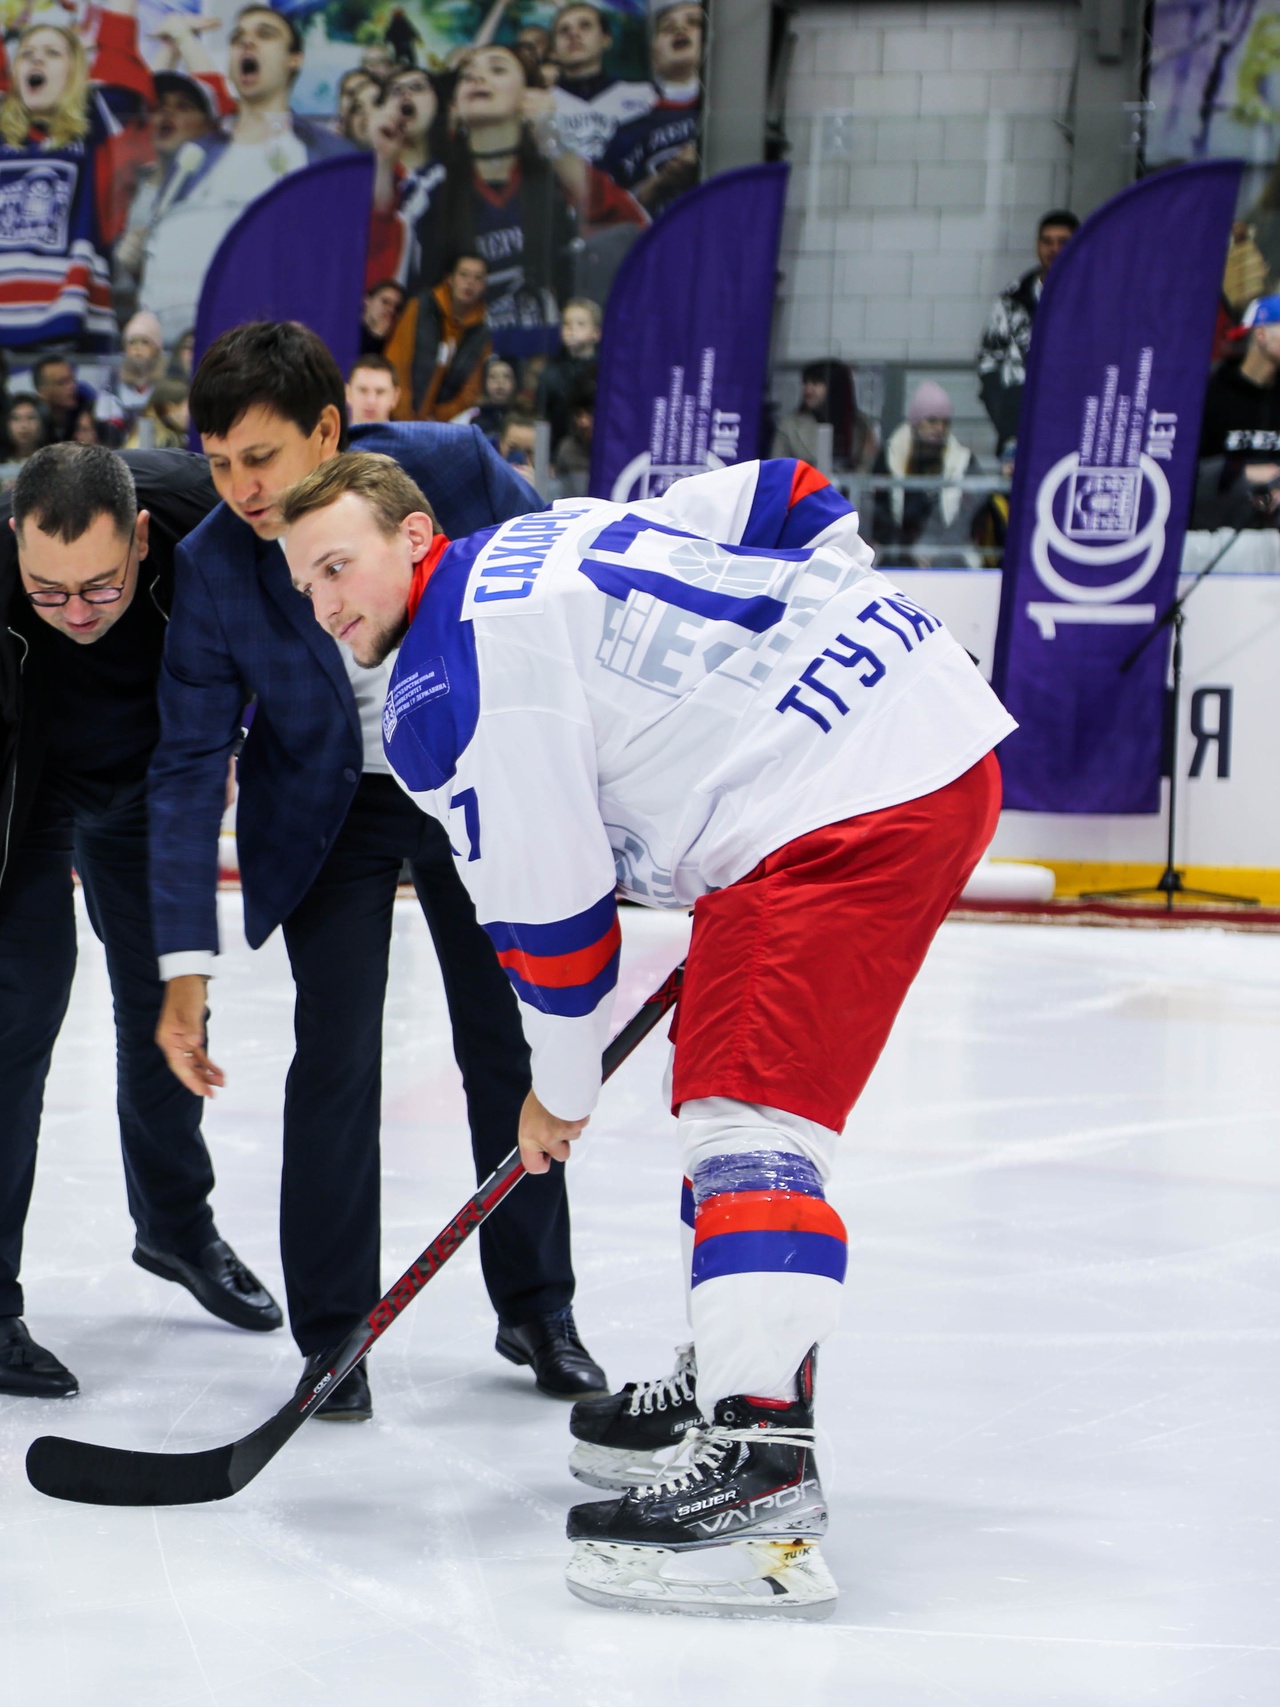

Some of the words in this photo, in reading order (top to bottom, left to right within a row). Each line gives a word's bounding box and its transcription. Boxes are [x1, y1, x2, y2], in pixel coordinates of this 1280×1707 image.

[775, 633, 886, 734] ТГУ
[368, 1200, 482, 1336] BAUER
[677, 1490, 737, 1517] BAUER
[699, 1479, 820, 1533] VAPOR
